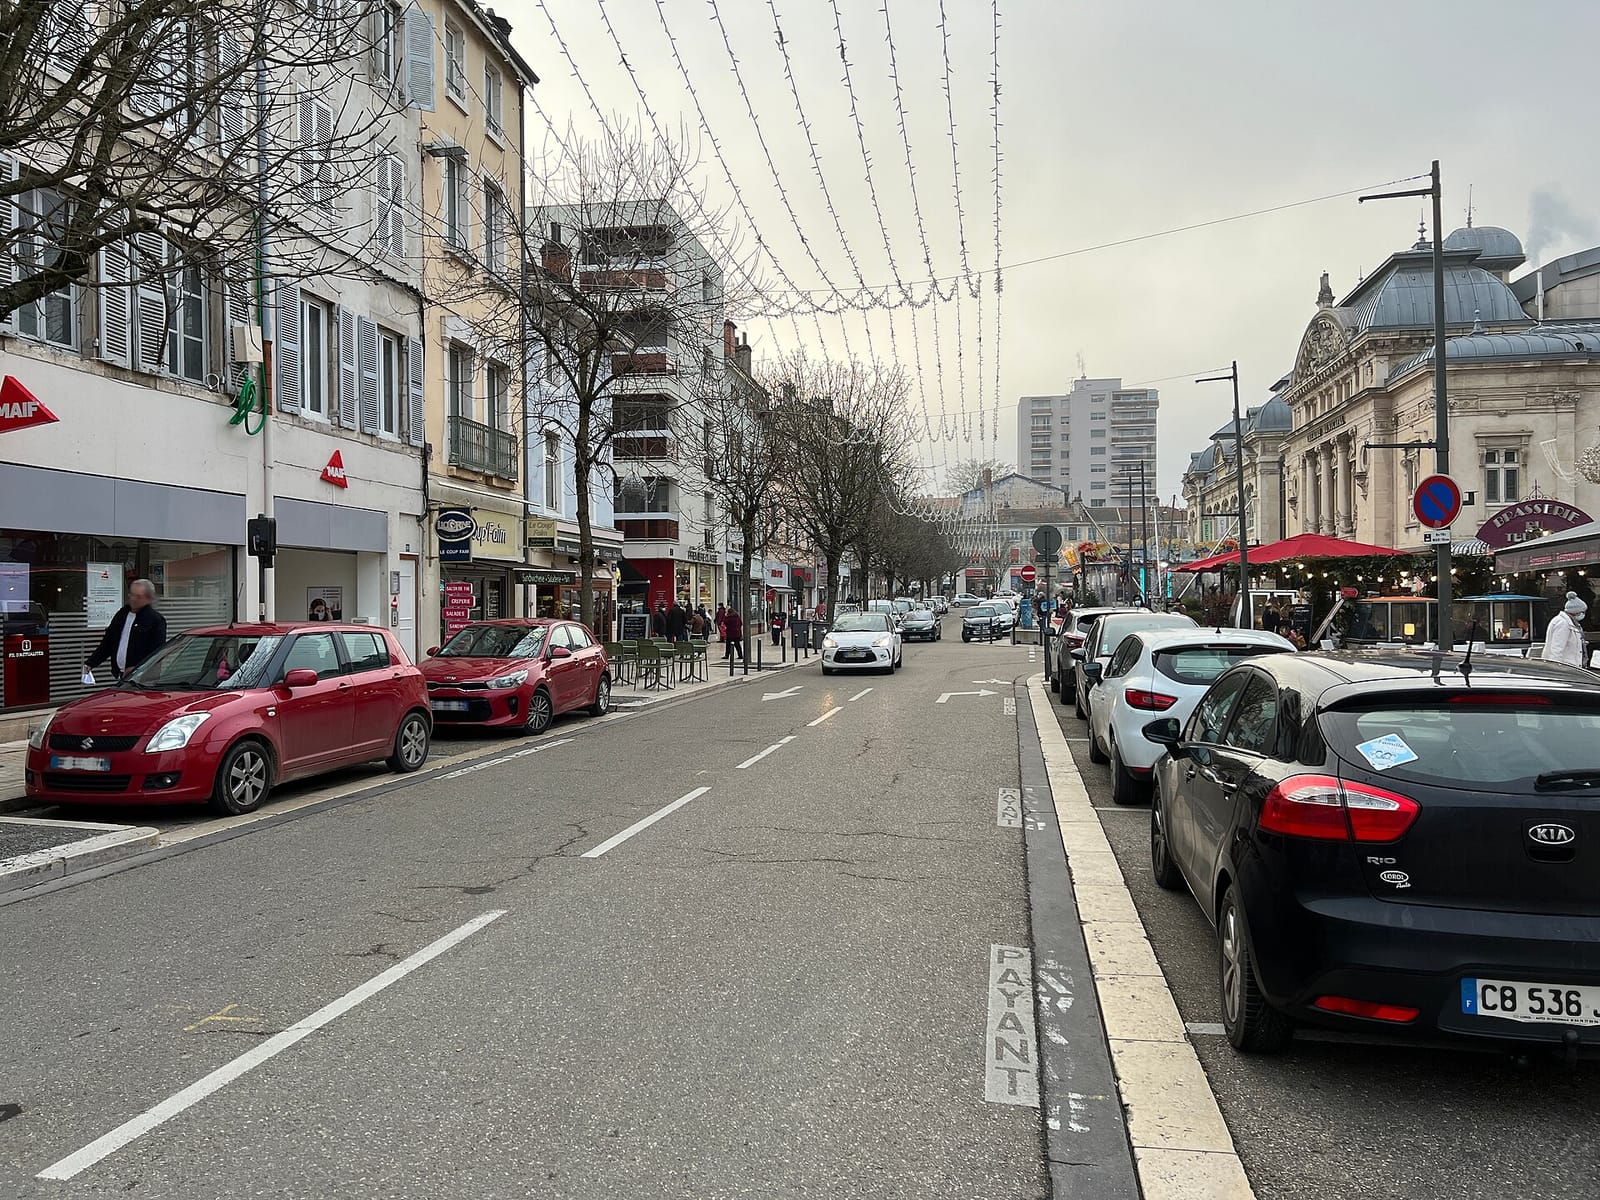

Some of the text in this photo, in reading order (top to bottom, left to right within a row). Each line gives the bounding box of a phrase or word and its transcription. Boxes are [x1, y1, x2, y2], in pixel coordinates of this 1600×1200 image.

[0, 401, 39, 419] MAIF
[1493, 503, 1581, 528] BRASSERIE
[1536, 828, 1568, 841] KIA
[1367, 856, 1397, 865] RIO
[1466, 1000, 1473, 1008] F
[1527, 987, 1582, 1017] 536
[995, 949, 1031, 1098] PAYANT
